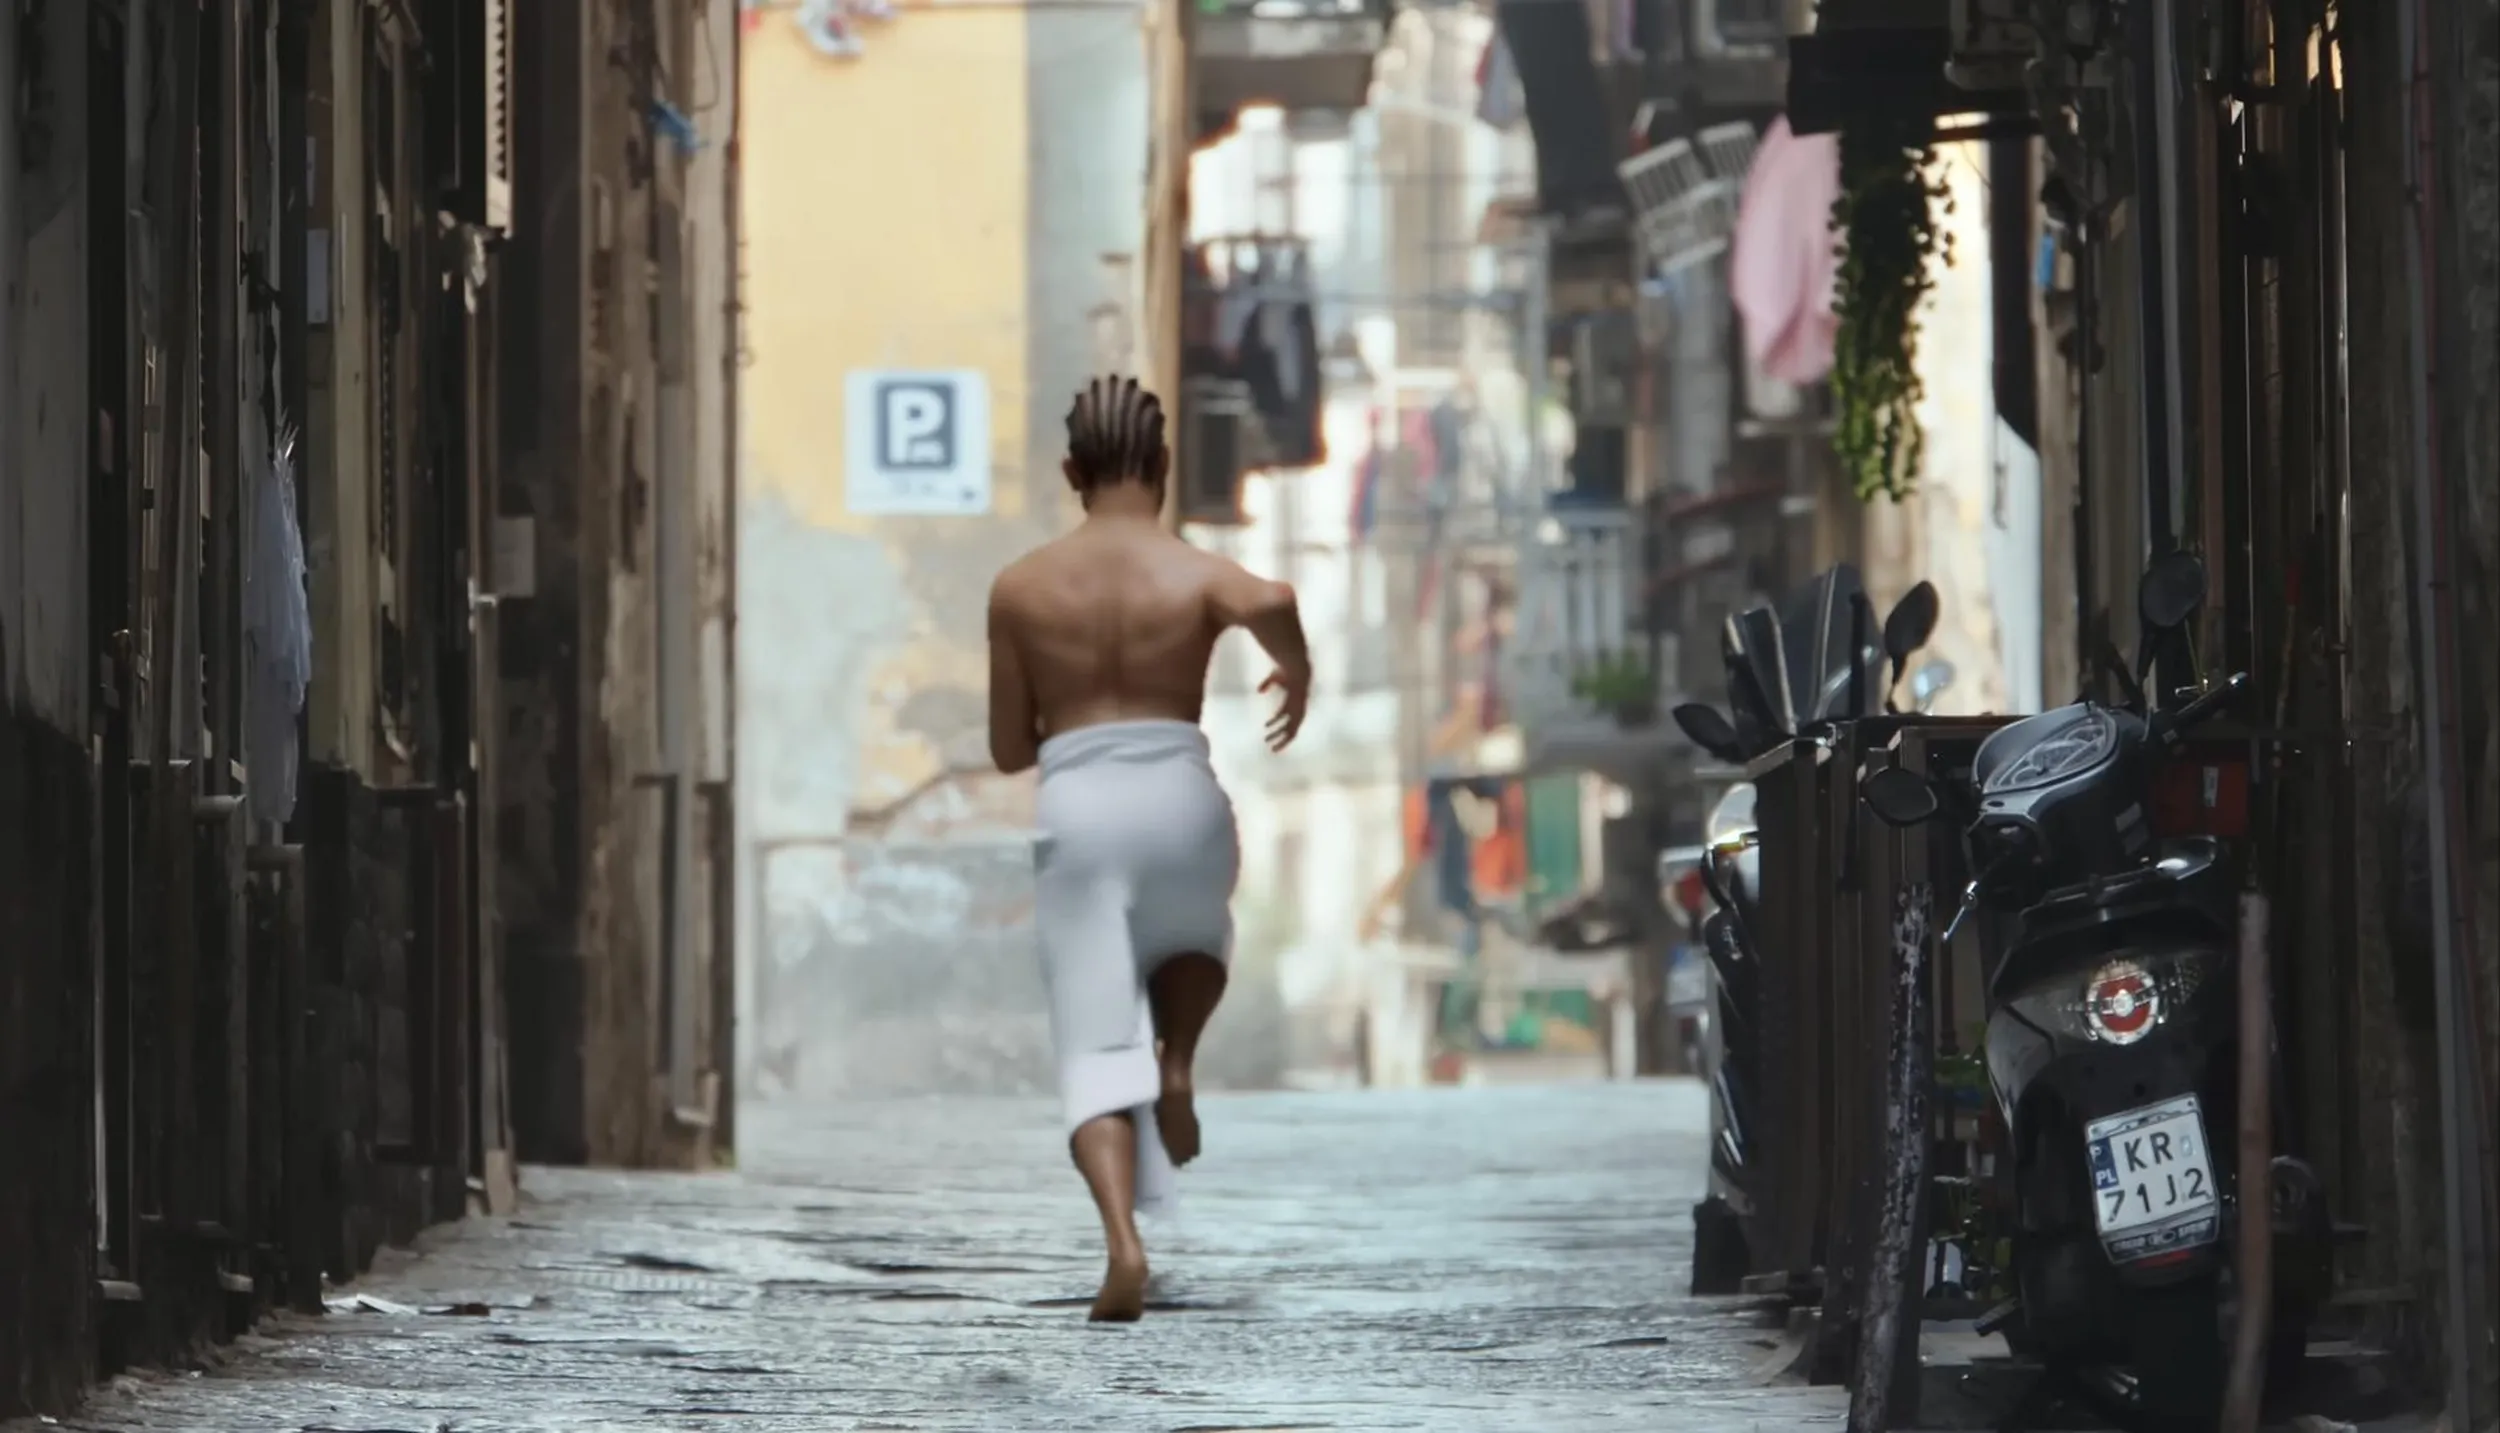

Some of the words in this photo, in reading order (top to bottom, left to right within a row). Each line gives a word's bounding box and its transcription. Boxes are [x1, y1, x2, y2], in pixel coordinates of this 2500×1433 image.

[888, 387, 945, 464] P
[2124, 1131, 2173, 1172] KR
[2095, 1168, 2117, 1186] PL
